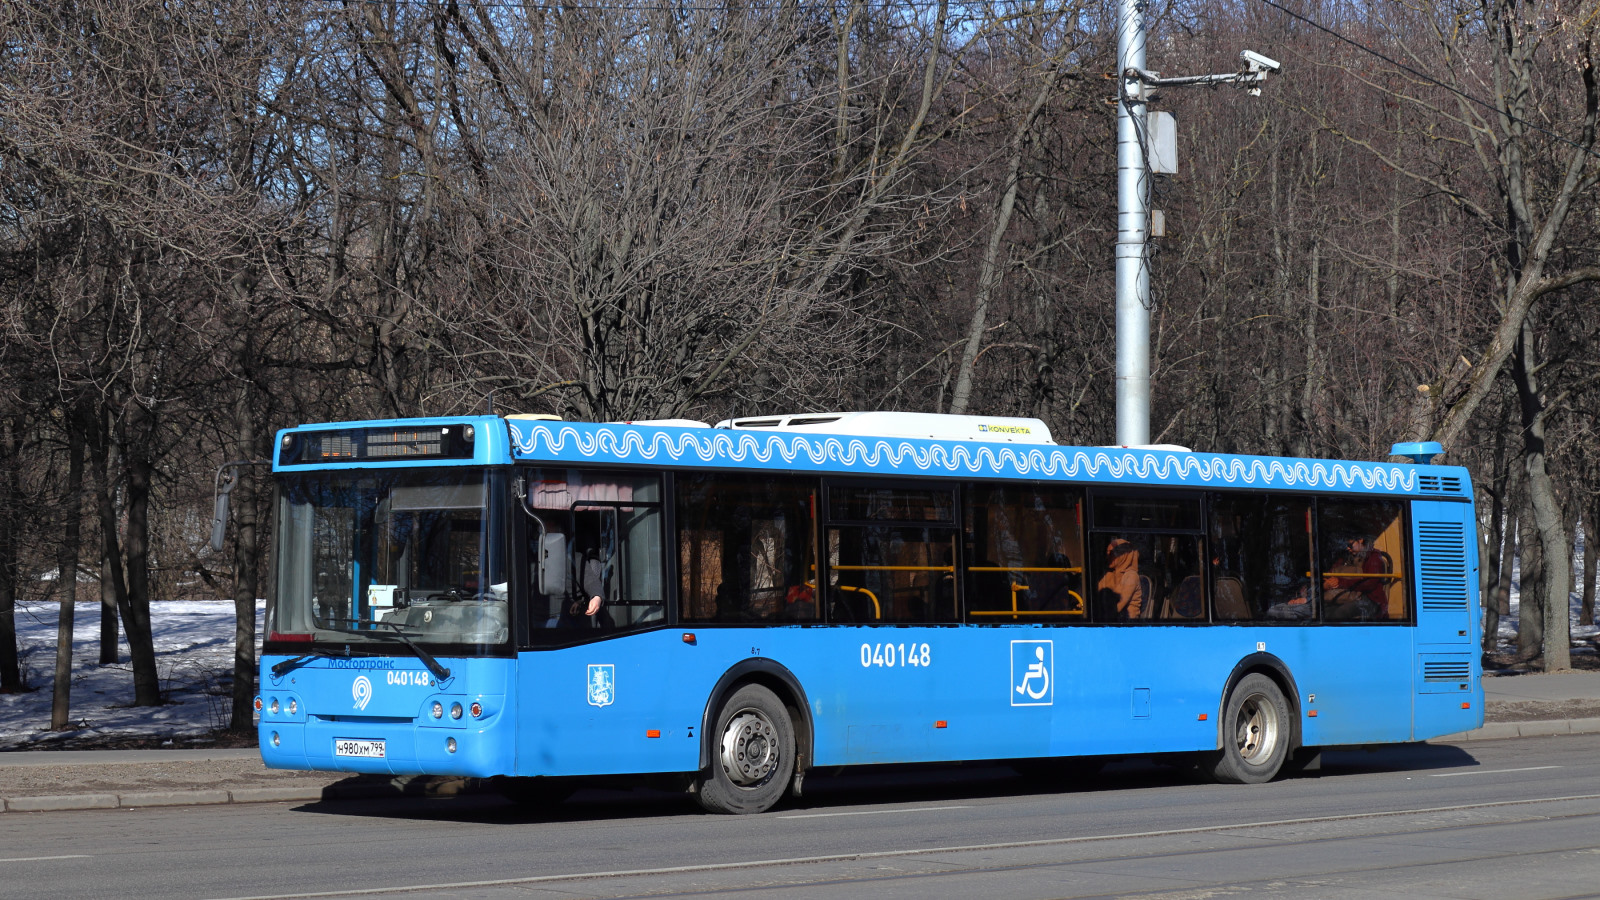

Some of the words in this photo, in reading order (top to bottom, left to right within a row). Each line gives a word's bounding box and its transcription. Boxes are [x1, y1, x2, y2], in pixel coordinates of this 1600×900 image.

[988, 425, 1031, 434] KONVEKTA
[860, 643, 931, 668] 040148
[328, 659, 395, 672] Мосгортранс
[387, 671, 429, 685] 040148
